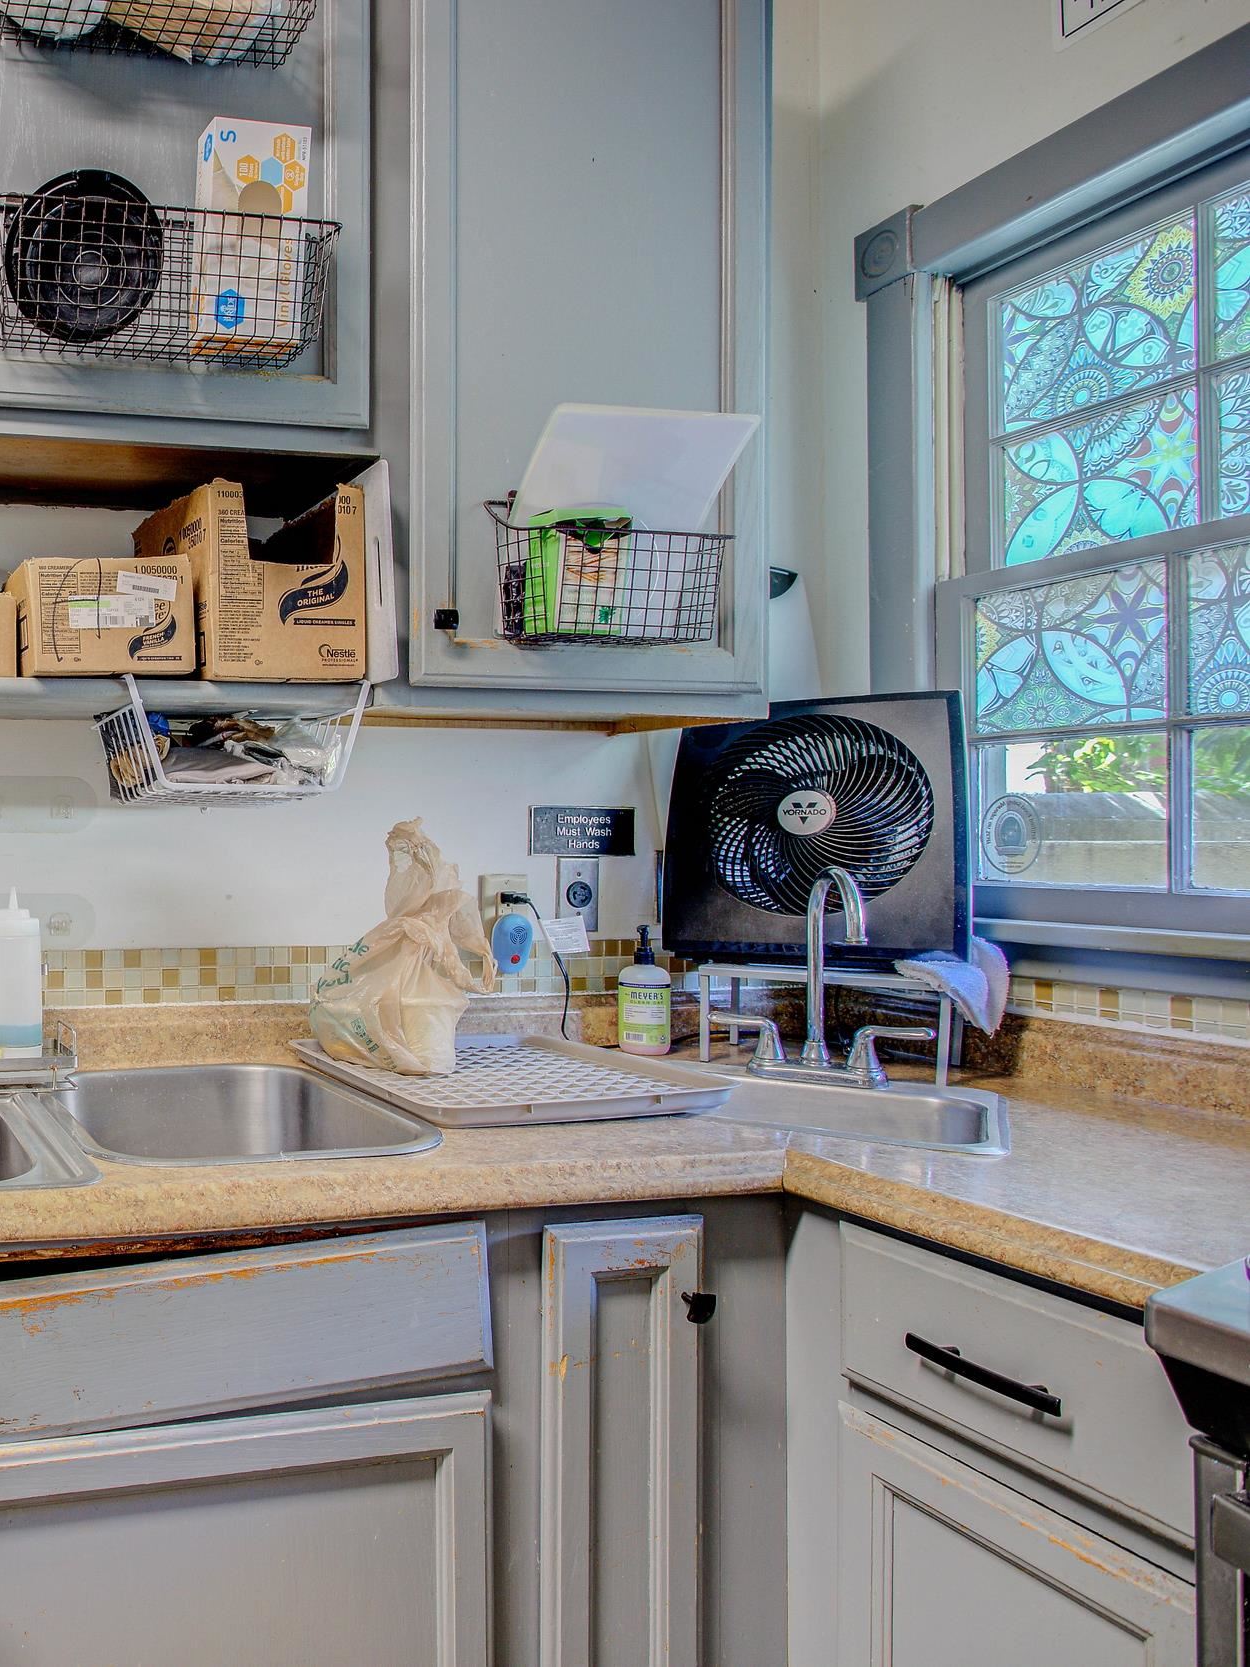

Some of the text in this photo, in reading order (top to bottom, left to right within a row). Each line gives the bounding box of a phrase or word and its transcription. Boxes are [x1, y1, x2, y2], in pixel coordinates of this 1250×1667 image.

[220, 130, 237, 143] S
[238, 162, 248, 177] 100
[276, 238, 293, 328] Vinyl Gloves
[141, 565, 178, 574] 0050000
[307, 588, 324, 598] THE
[297, 593, 335, 607] ORIGINAL
[142, 631, 164, 641] FRENCH
[142, 637, 165, 646] VANILLA
[782, 808, 827, 816] VORNADO
[557, 813, 611, 826] Employees
[556, 826, 612, 837] Must Wash
[568, 839, 600, 849] Hands
[630, 991, 664, 1000] MEYER'S
